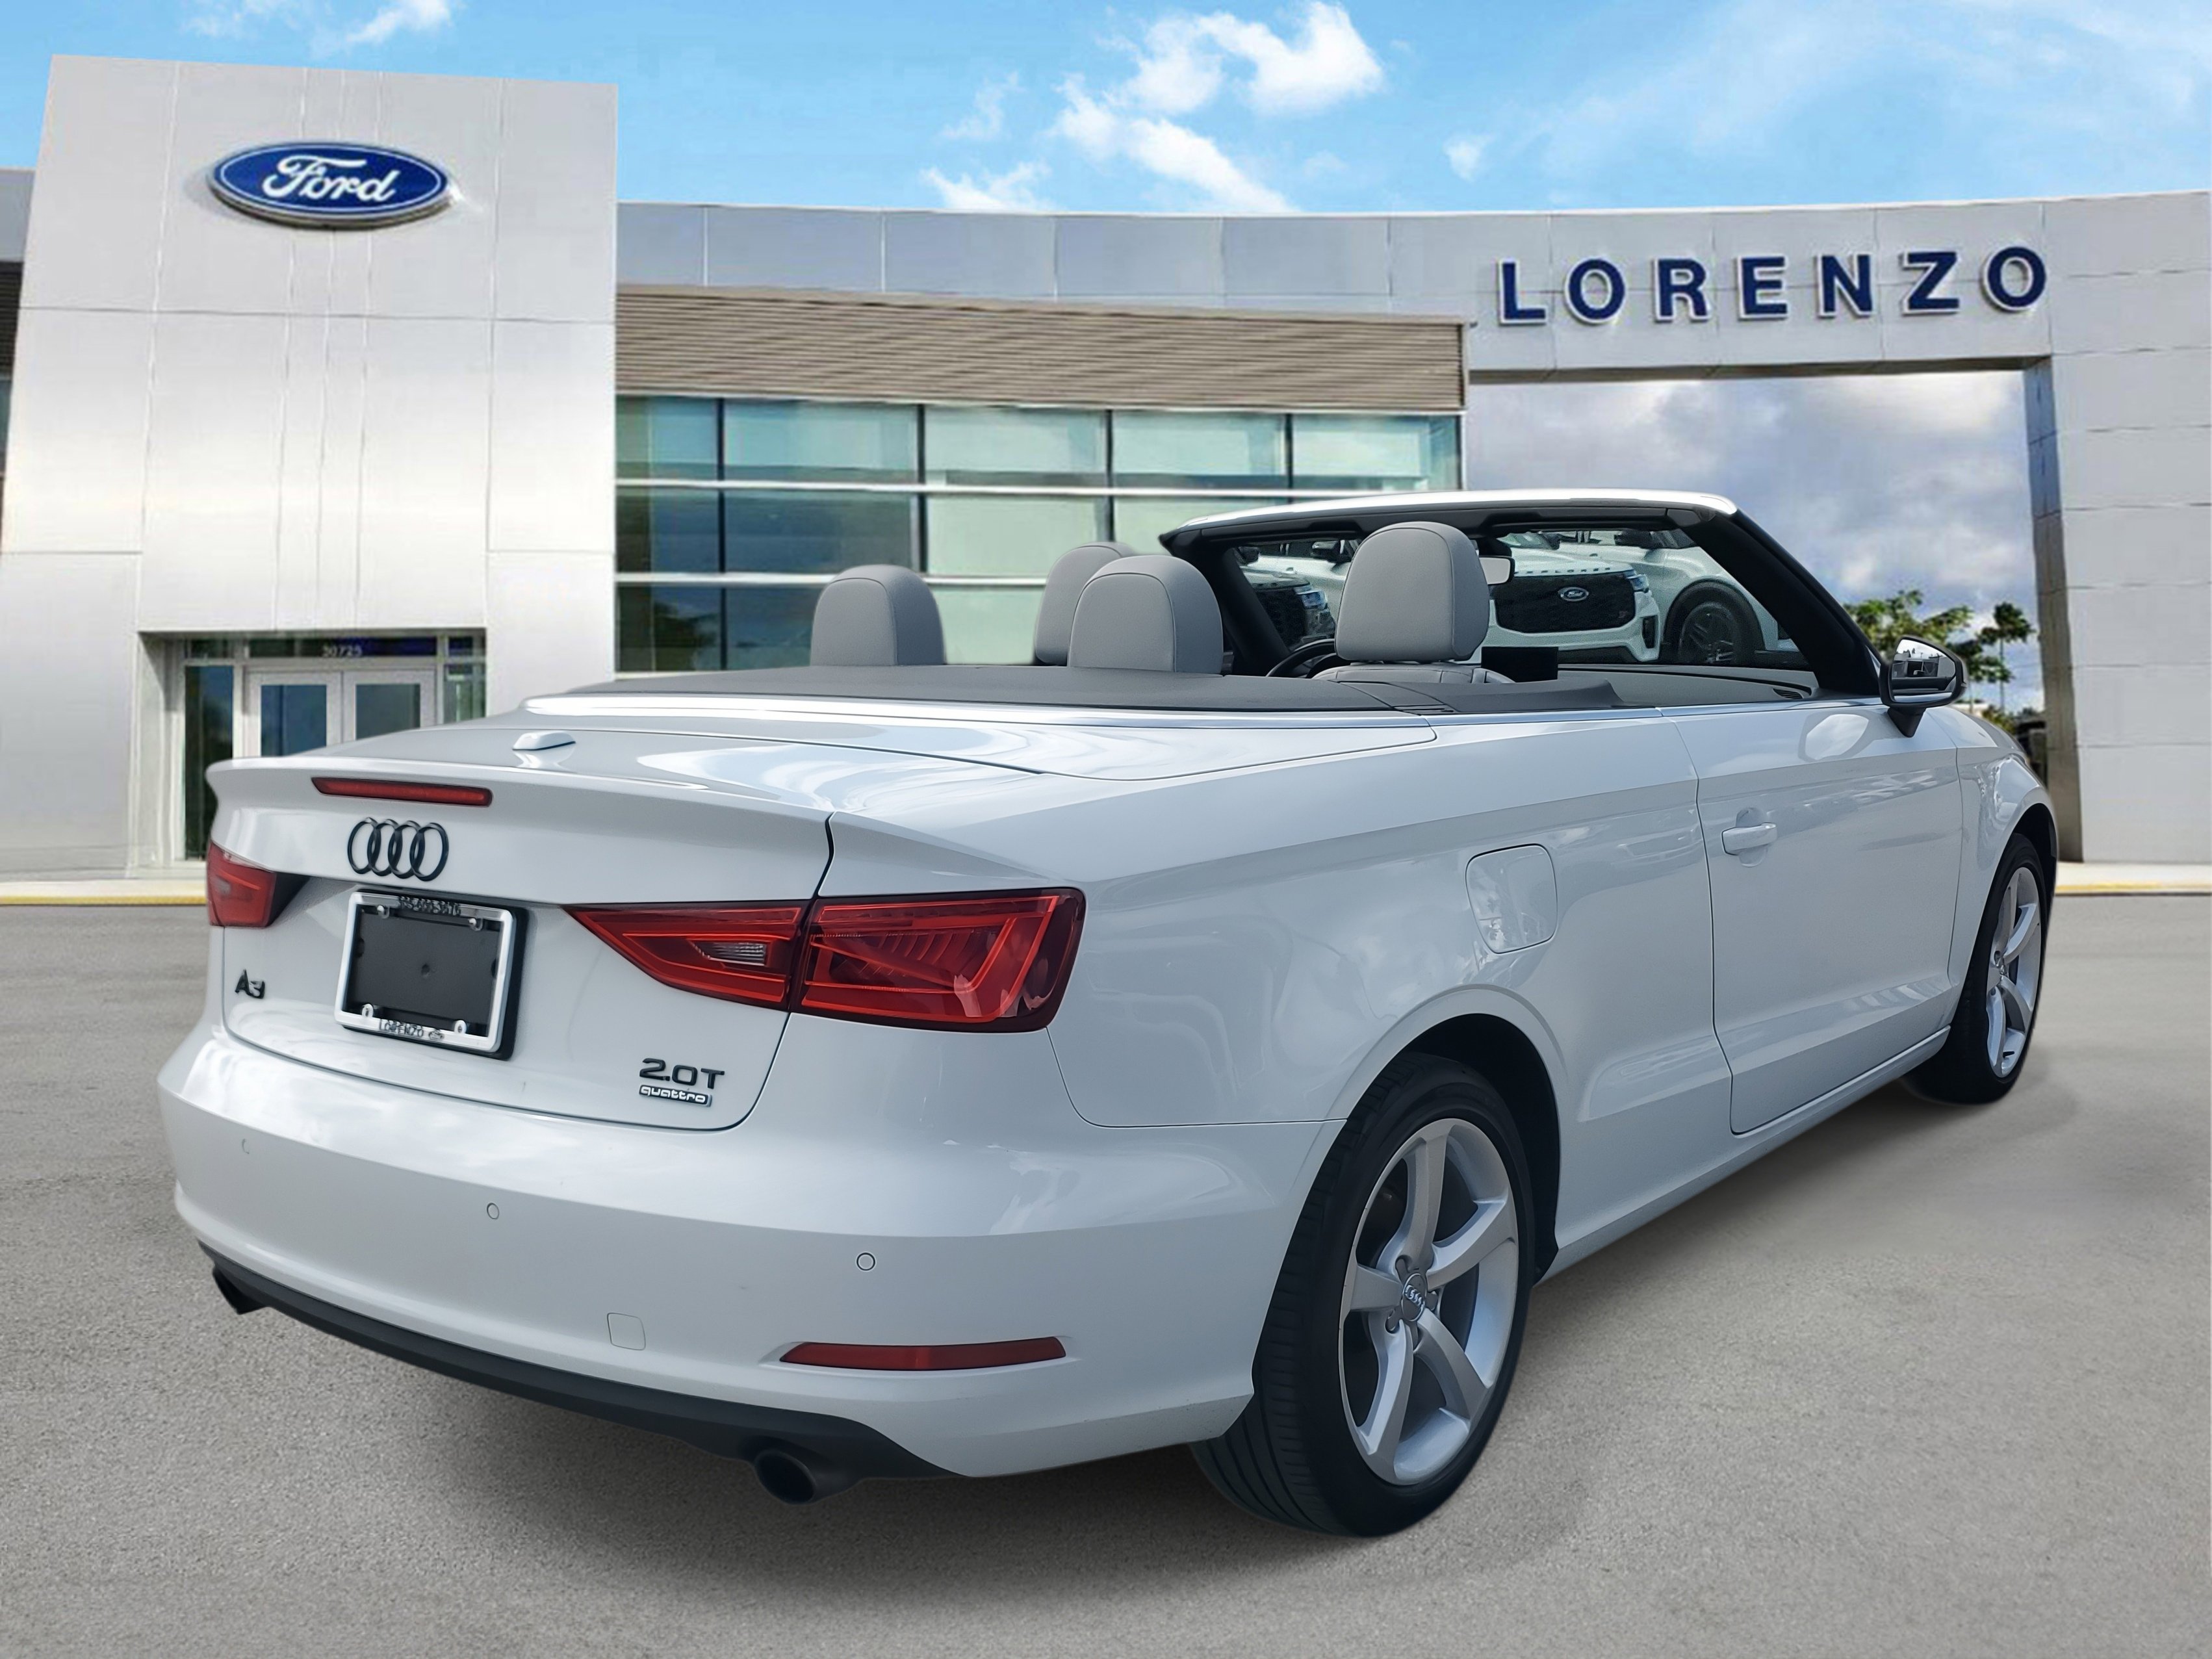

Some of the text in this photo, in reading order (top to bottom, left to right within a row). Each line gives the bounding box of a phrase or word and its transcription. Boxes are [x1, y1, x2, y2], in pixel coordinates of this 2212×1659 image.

[262, 154, 400, 202] Ford
[1500, 246, 2047, 324] LORENZO
[235, 969, 266, 999] A3
[639, 1057, 725, 1090] 2.0T
[640, 1085, 706, 1104] quattro
